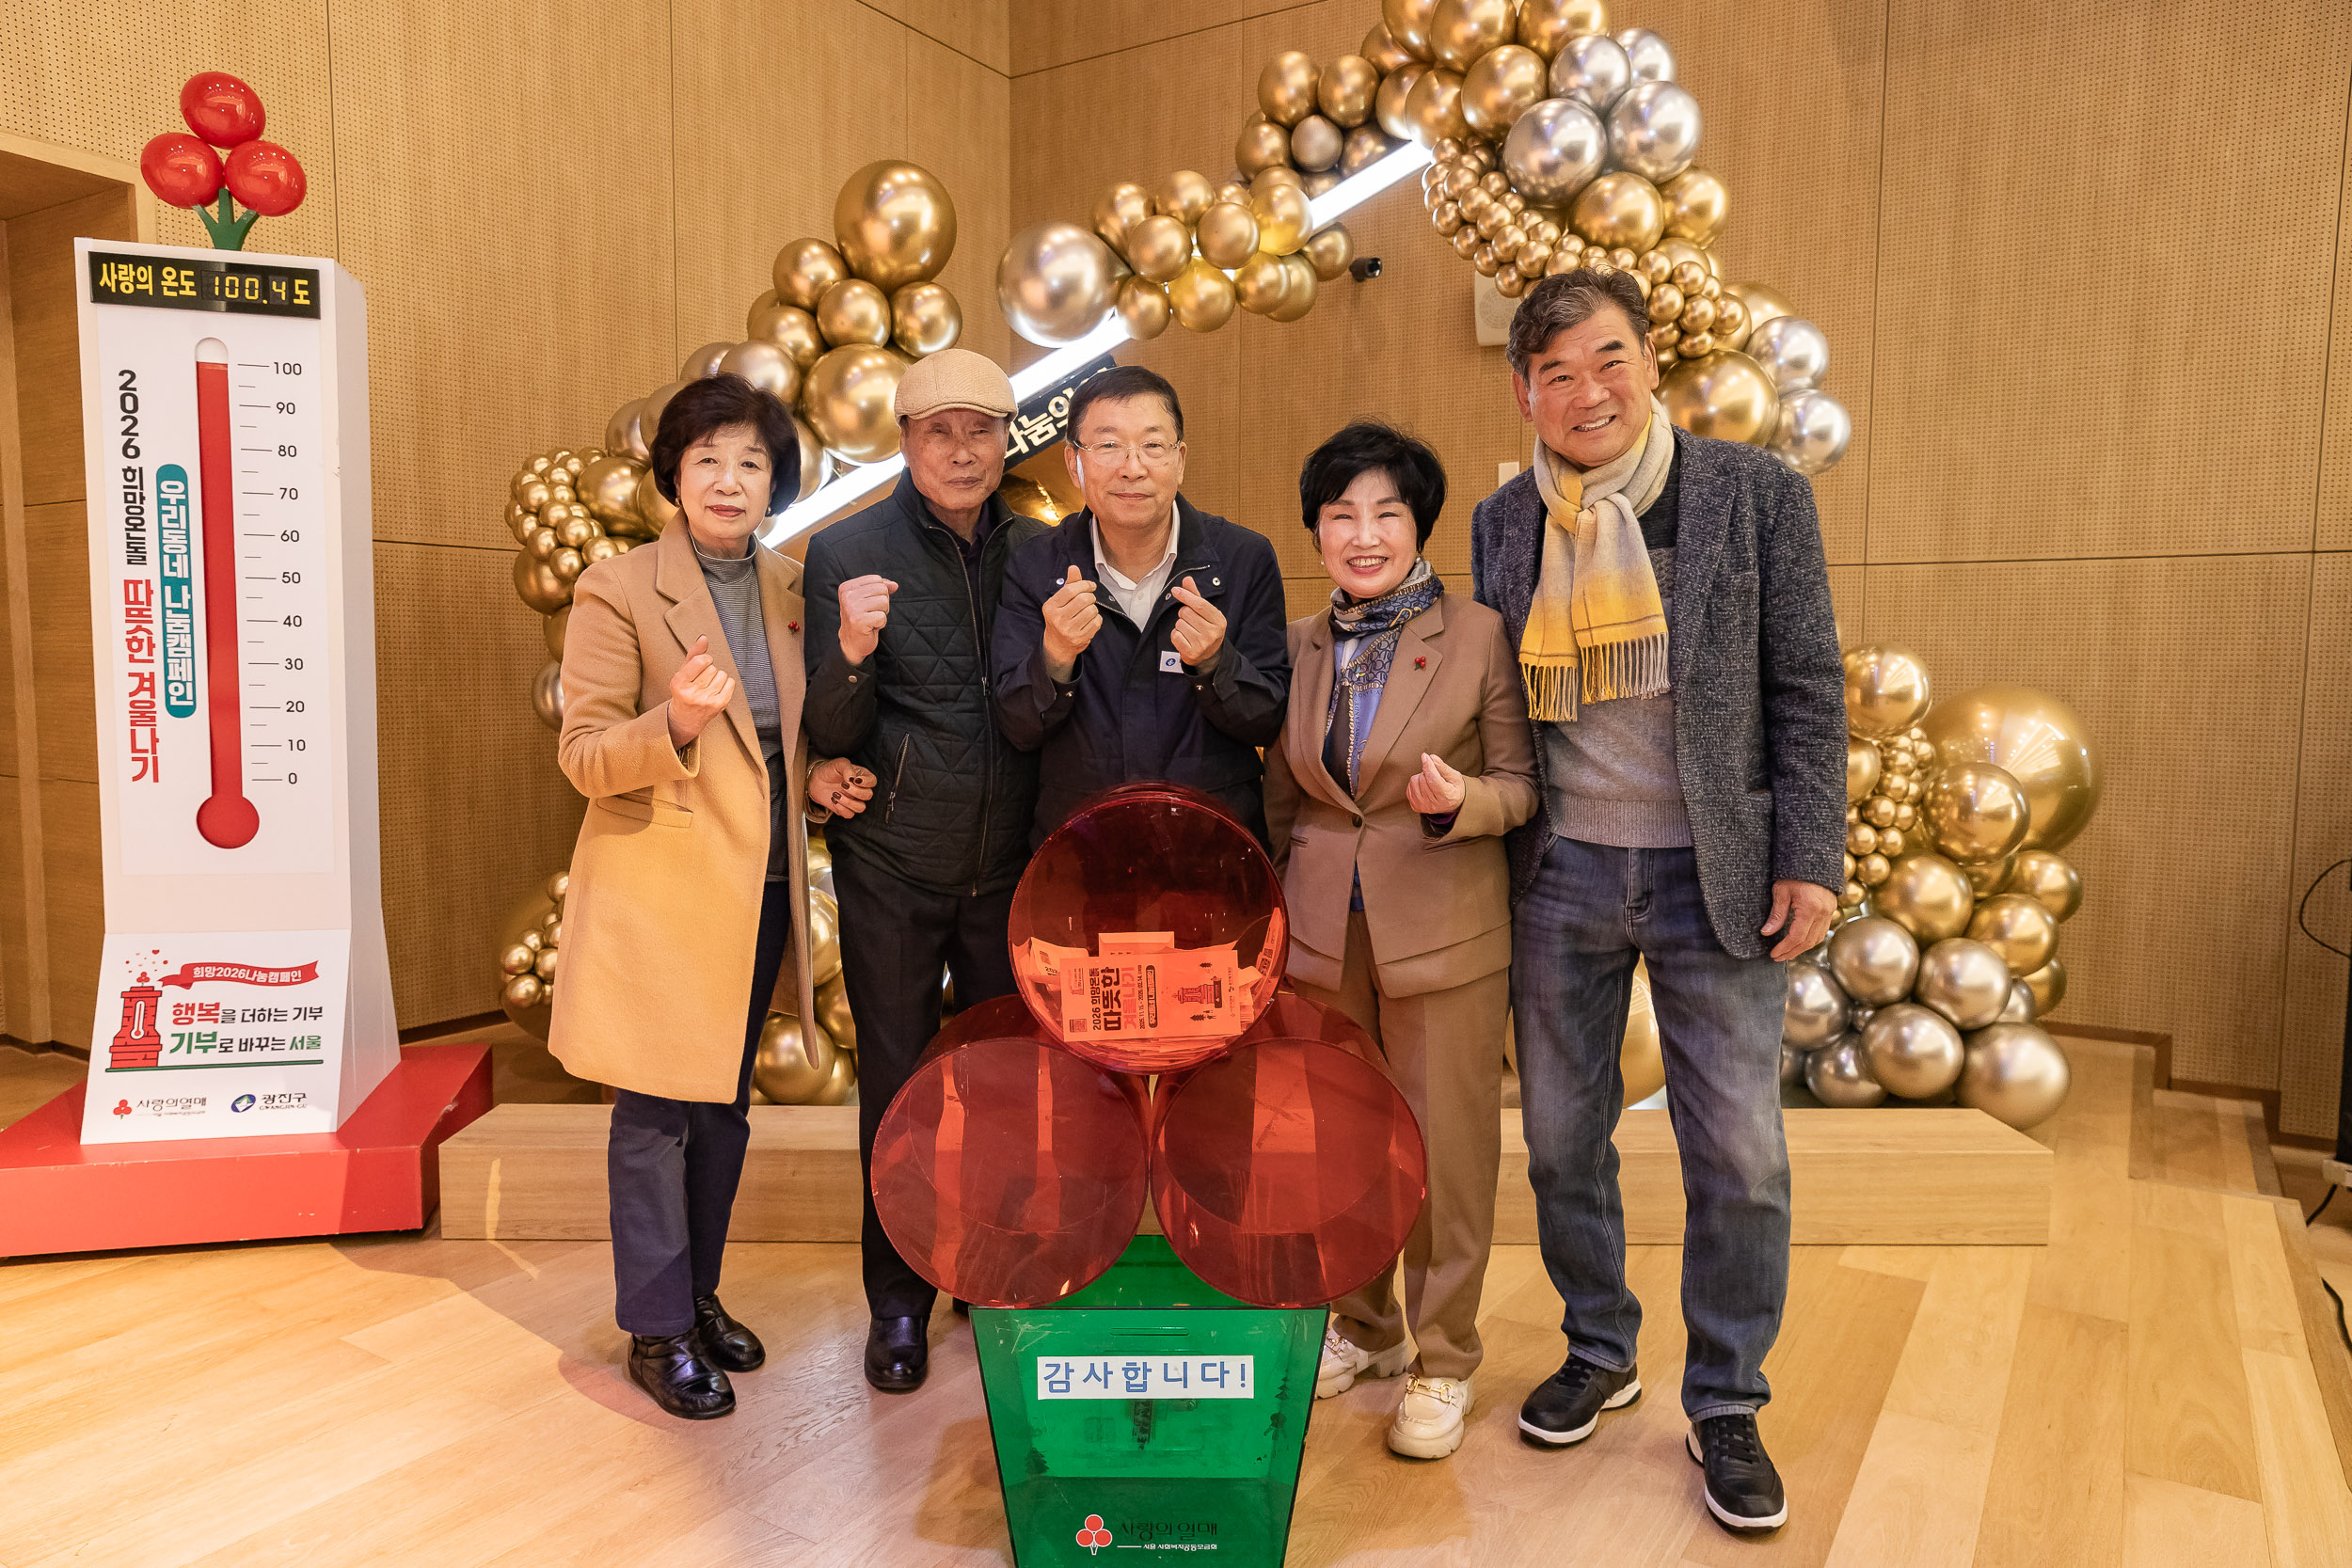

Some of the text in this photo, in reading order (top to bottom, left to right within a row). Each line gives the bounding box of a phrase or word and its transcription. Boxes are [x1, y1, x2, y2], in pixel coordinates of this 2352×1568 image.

[100, 261, 153, 296] 사랑의
[161, 266, 198, 297] 온도
[274, 361, 302, 375] 100
[276, 402, 296, 415] 90
[278, 445, 297, 458] 80
[119, 369, 148, 566] 2026 희망온돌
[279, 487, 298, 500] 70
[280, 530, 300, 543] 60
[281, 572, 301, 584] 50
[160, 480, 195, 706] 우리동네 나눔캠페인
[282, 615, 303, 627] 40
[284, 657, 304, 671] 30
[123, 578, 159, 783] 따뜻한 겨울나기
[286, 701, 305, 713] 20
[288, 739, 307, 752] 10
[288, 772, 298, 784] 0
[193, 966, 302, 984] 희망2026나눔캠페인
[1101, 966, 1121, 1031] 따뜻한
[1121, 967, 1137, 1030] 겨울나기
[172, 1002, 323, 1025] 행복을 더하는 기부
[1091, 1006, 1102, 1031] 2026
[169, 1031, 322, 1054] 기부로 바꾸는 서울
[261, 1092, 307, 1105] 광진구
[1043, 1360, 1246, 1393] 감사합니다!
